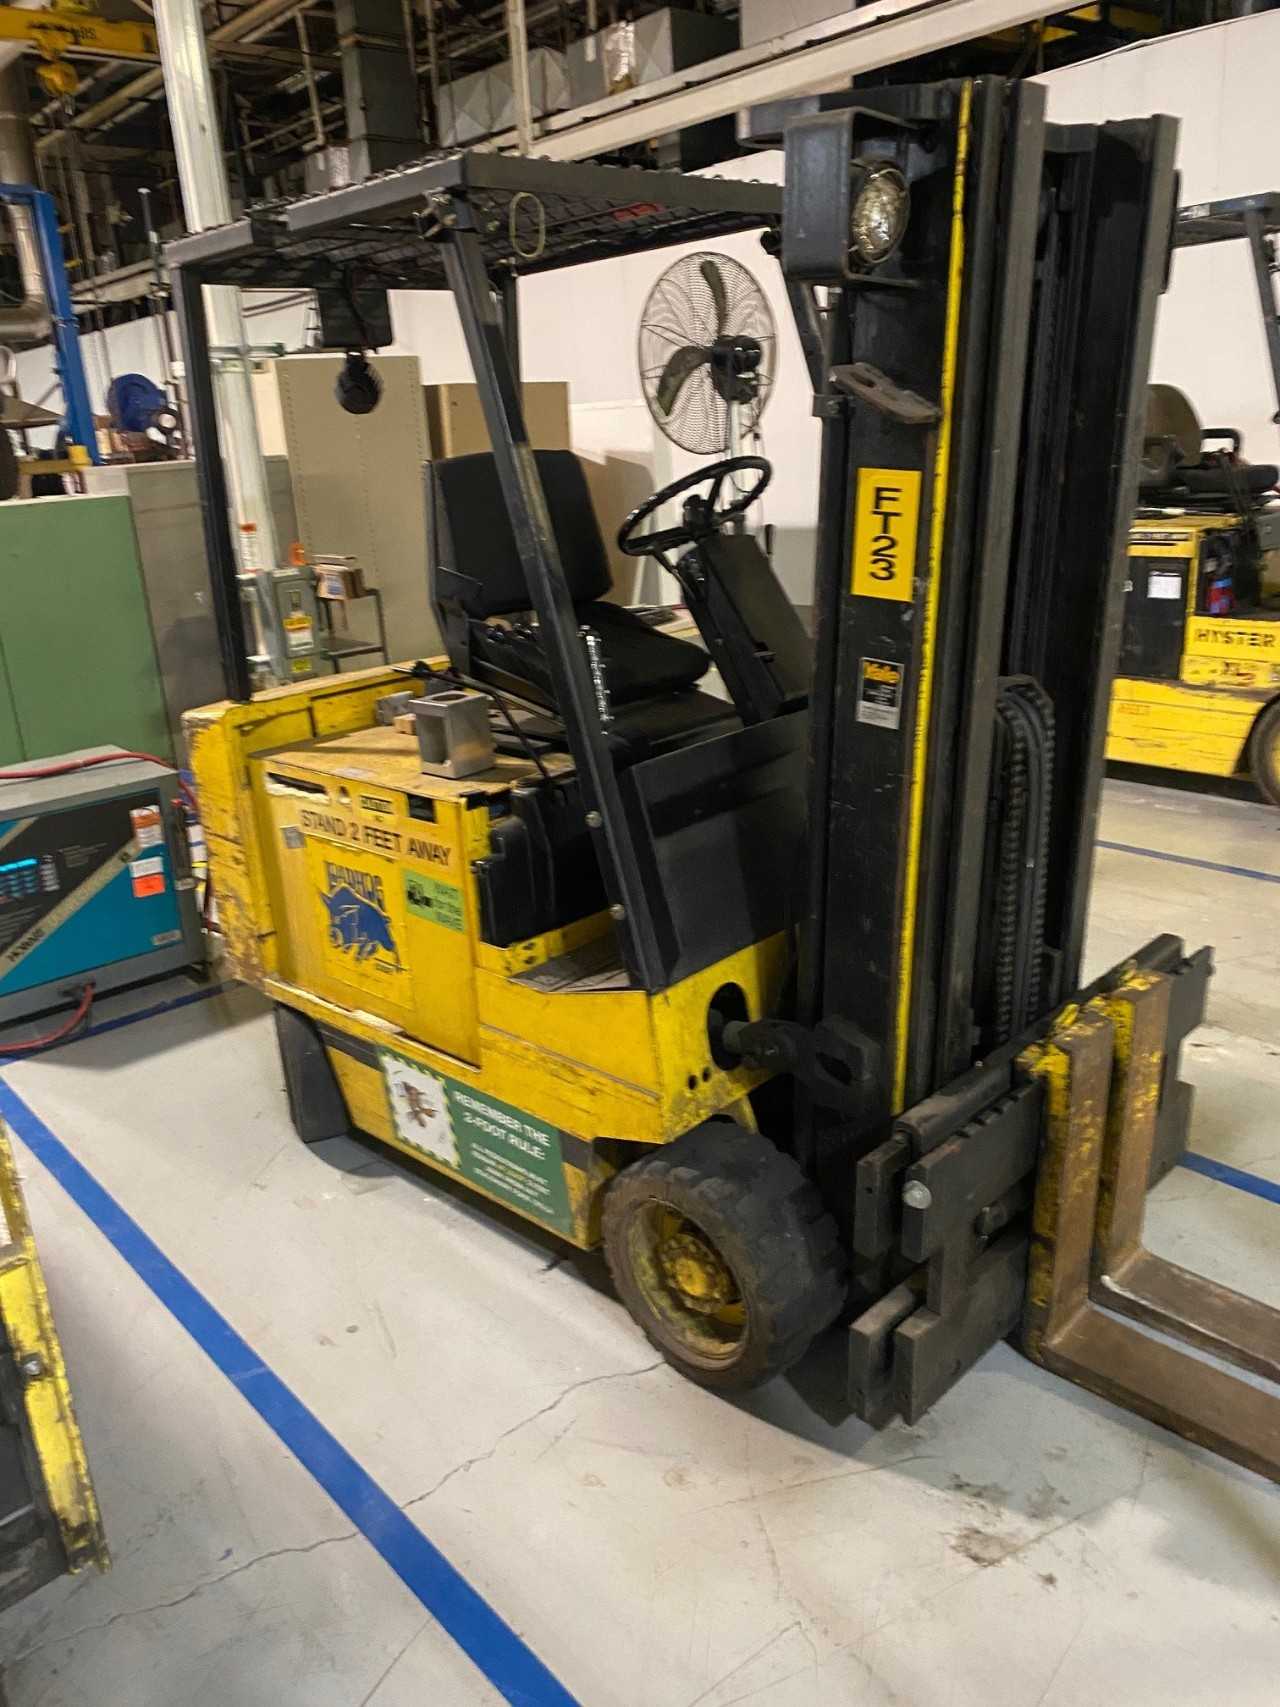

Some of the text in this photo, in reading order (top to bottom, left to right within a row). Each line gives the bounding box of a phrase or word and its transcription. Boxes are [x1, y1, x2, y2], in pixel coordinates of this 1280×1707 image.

[869, 486, 903, 581] FT23
[1195, 629, 1275, 647] HYSTER
[863, 661, 901, 684] Yale
[301, 809, 347, 838] STAND
[350, 822, 360, 841] 2
[364, 825, 401, 852] FEET
[407, 837, 451, 866] AWAY
[453, 1090, 551, 1147] REMEMBER THE
[463, 1111, 507, 1141] 2-FOOT
